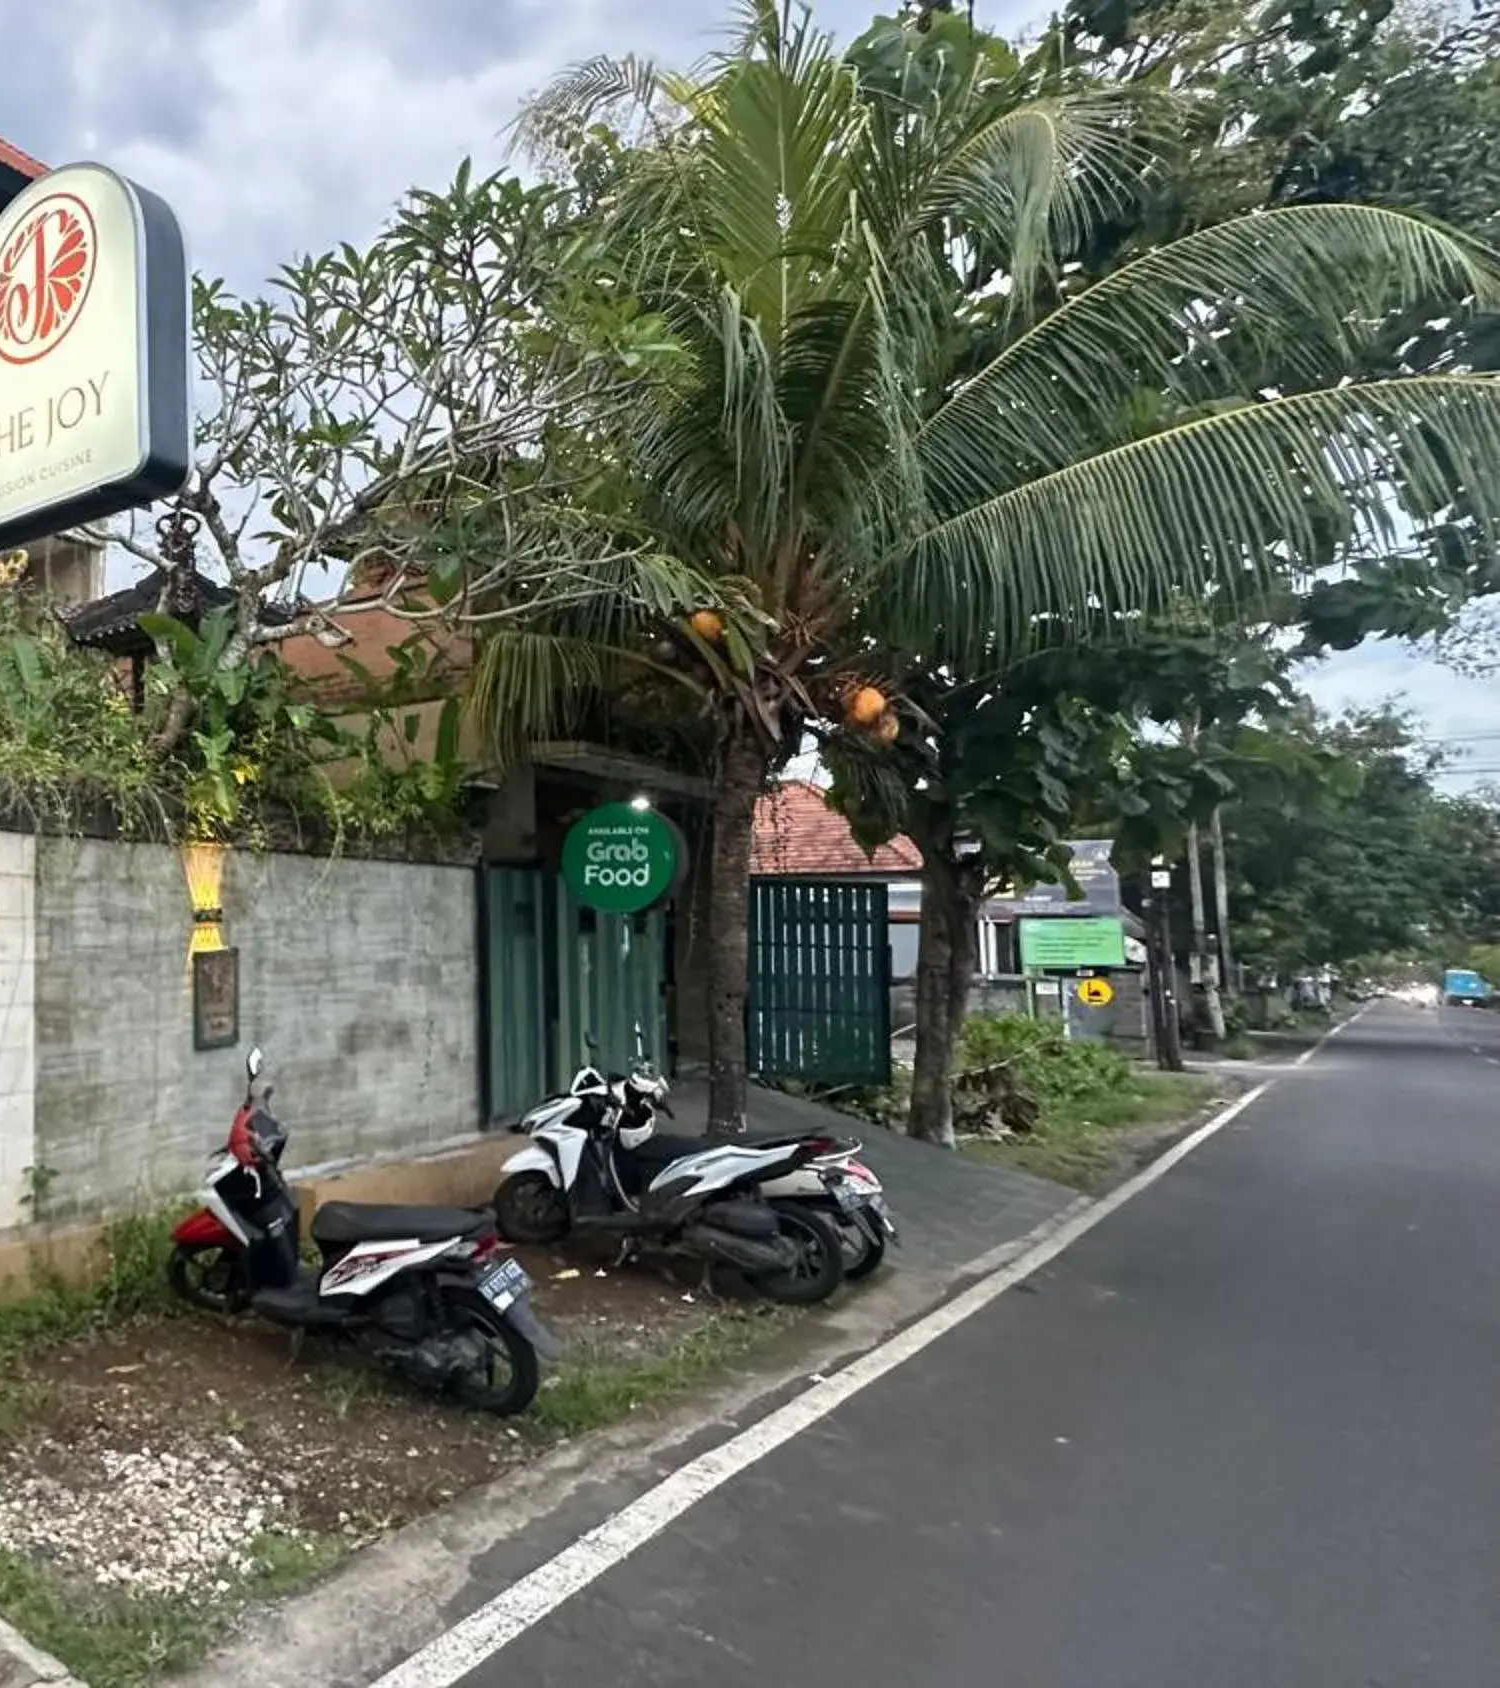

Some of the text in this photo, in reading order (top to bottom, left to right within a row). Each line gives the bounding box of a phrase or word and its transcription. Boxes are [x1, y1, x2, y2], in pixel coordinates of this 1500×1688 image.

[47, 370, 111, 447] JOY
[40, 448, 93, 481] CUISINE
[587, 826, 650, 836] AVAILABLE ON
[586, 837, 649, 862] Grab
[584, 863, 650, 887] Food
